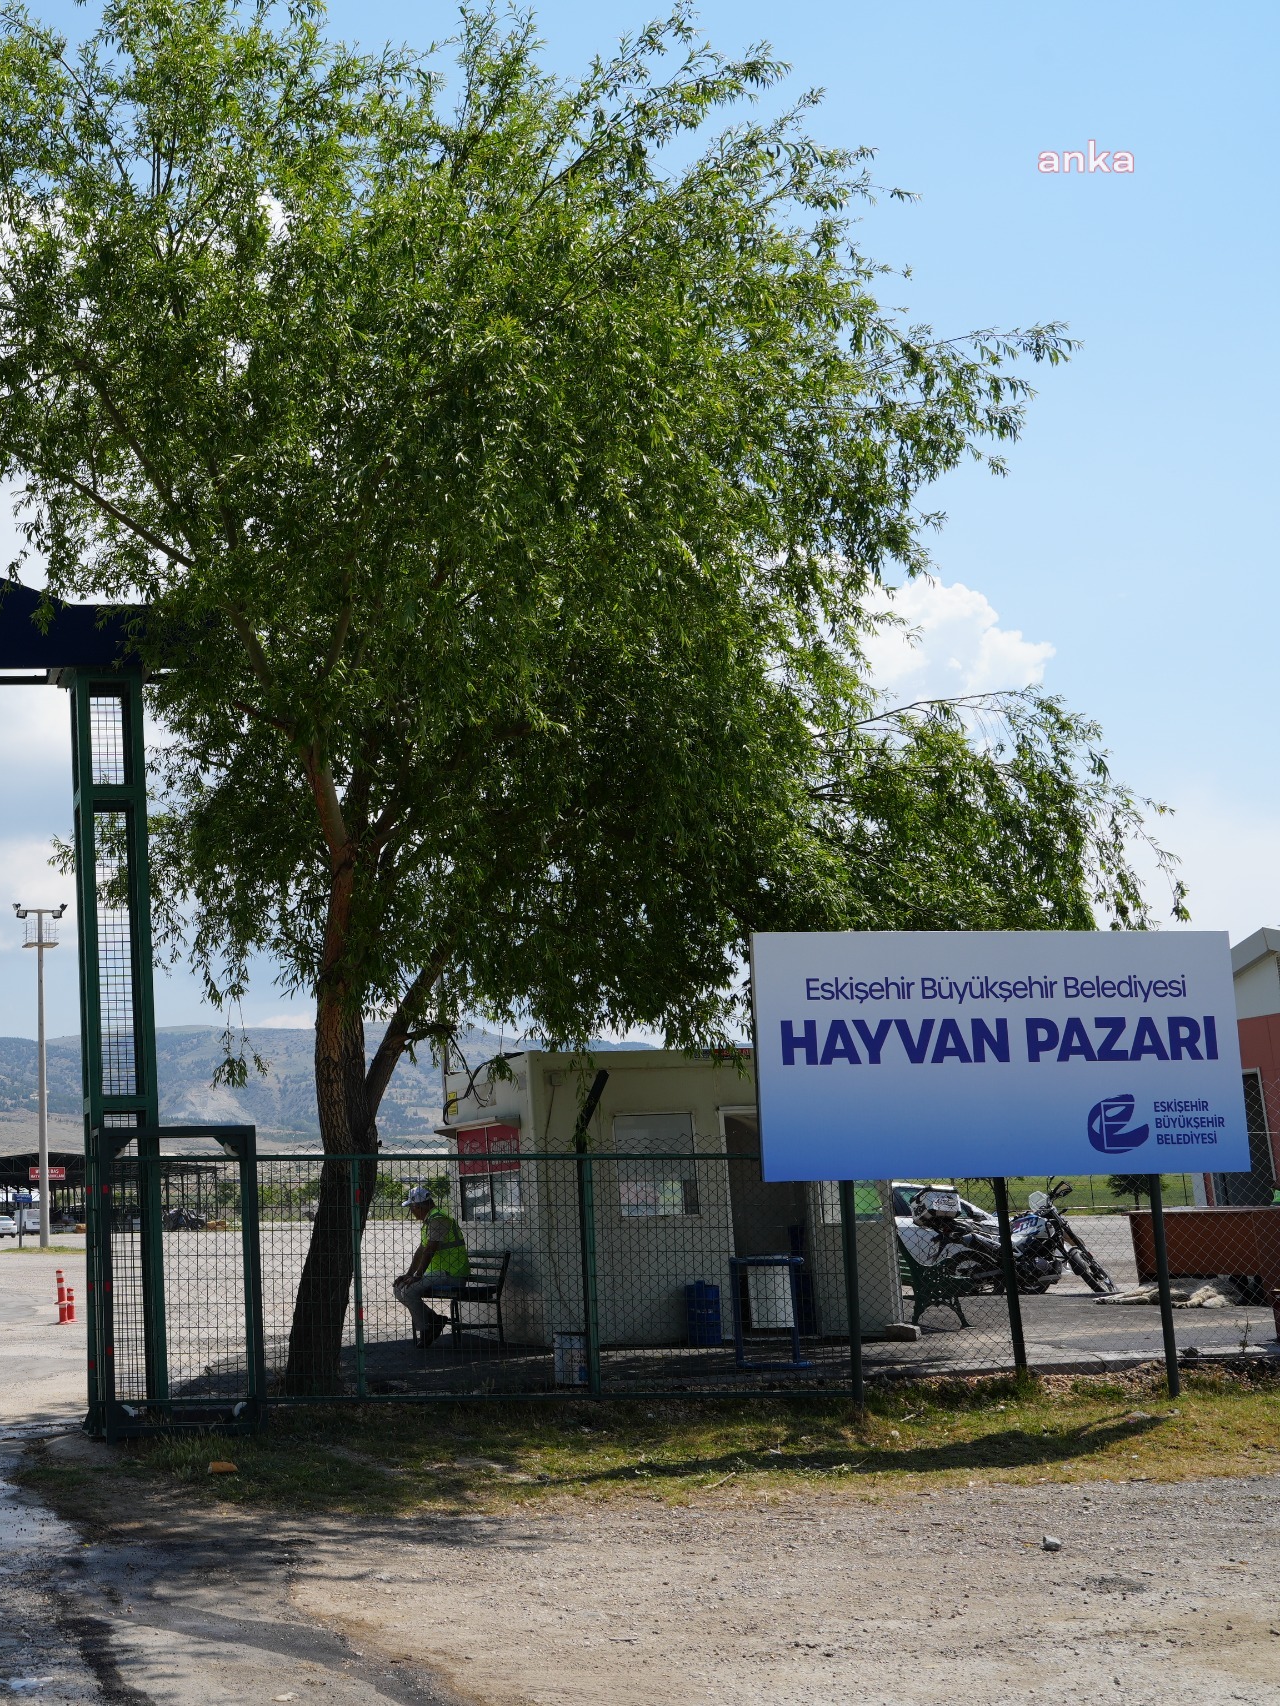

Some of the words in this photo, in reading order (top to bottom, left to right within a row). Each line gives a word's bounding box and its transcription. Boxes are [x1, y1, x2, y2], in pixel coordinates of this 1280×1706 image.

[805, 975, 915, 1004] Eskişehir
[921, 975, 1058, 1004] Büyükşehir
[1063, 974, 1187, 1003] Belediyesi
[780, 1017, 1011, 1066] HAYVAN
[1025, 1015, 1219, 1063] PAZARI
[1153, 1098, 1209, 1114] ESKİŞEHİR
[1155, 1114, 1225, 1130] BÜYÜKŞEHİR
[1156, 1130, 1218, 1145] BELEDİYESİ
